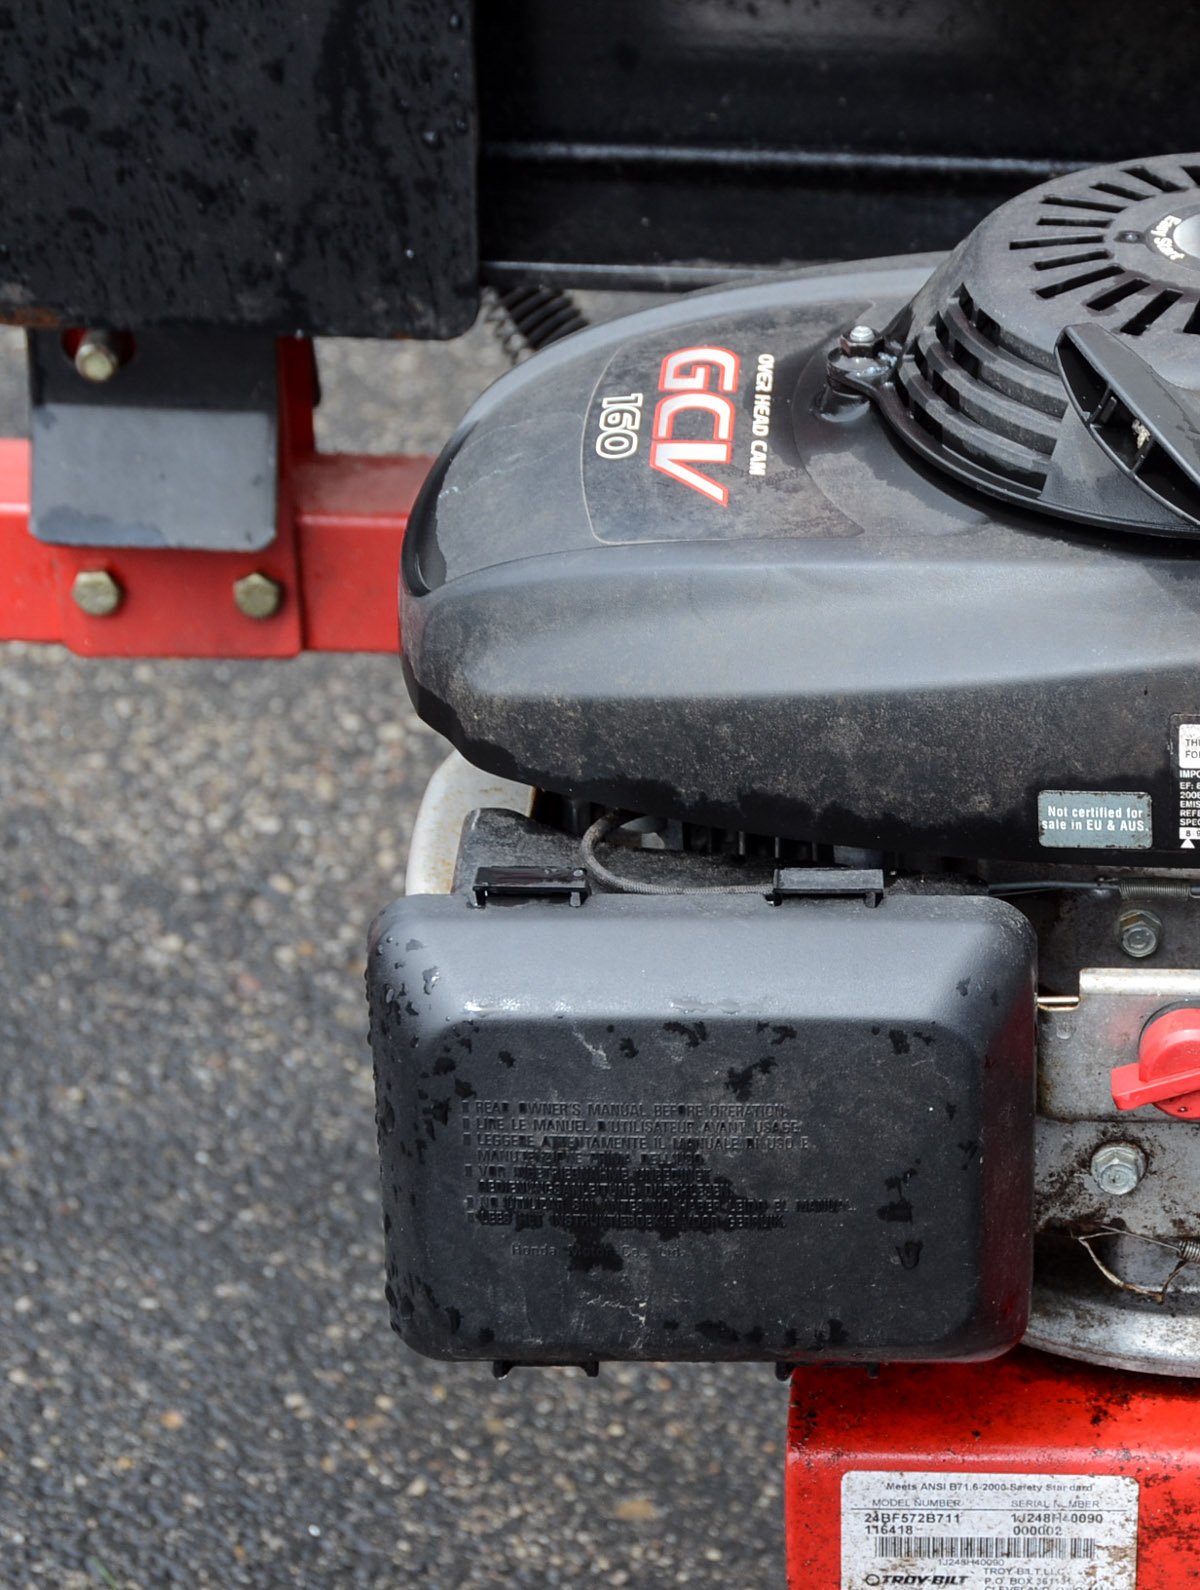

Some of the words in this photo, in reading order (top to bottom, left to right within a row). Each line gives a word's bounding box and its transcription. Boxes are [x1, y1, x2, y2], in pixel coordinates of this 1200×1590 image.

[1151, 214, 1182, 238] Easy
[1153, 237, 1185, 261] Start
[756, 353, 775, 393] OVER
[752, 394, 772, 437] HEAD
[596, 393, 643, 459] 160
[649, 345, 741, 507] GCV
[749, 439, 768, 477] CAM
[1179, 782, 1194, 790] EF:
[1047, 805, 1068, 817] Not
[1072, 806, 1122, 818] certified
[1126, 807, 1143, 819] for
[1041, 819, 1067, 830] sale
[1071, 819, 1083, 831] in
[1086, 819, 1102, 831] EU
[1106, 820, 1115, 831] &
[1120, 820, 1149, 832] AUS.
[588, 1102, 646, 1116] MANUAL
[512, 1117, 527, 1130] LE
[533, 1117, 591, 1132] MANUEL
[511, 1242, 557, 1256] Honda
[885, 1482, 917, 1491] Meets
[920, 1482, 946, 1491] ANSI
[1010, 1483, 1043, 1493] Safety
[1046, 1483, 1093, 1492] Standard
[872, 1499, 910, 1507] MODEL
[914, 1499, 961, 1508] NUMBER
[1011, 1500, 1049, 1508] SERIAL
[864, 1513, 961, 1523] 24BF572B711
[865, 1525, 913, 1535] 116418
[1013, 1526, 1062, 1536] 000002
[880, 1575, 969, 1585] TROY-BILT
[1010, 1577, 1036, 1585] BOX
